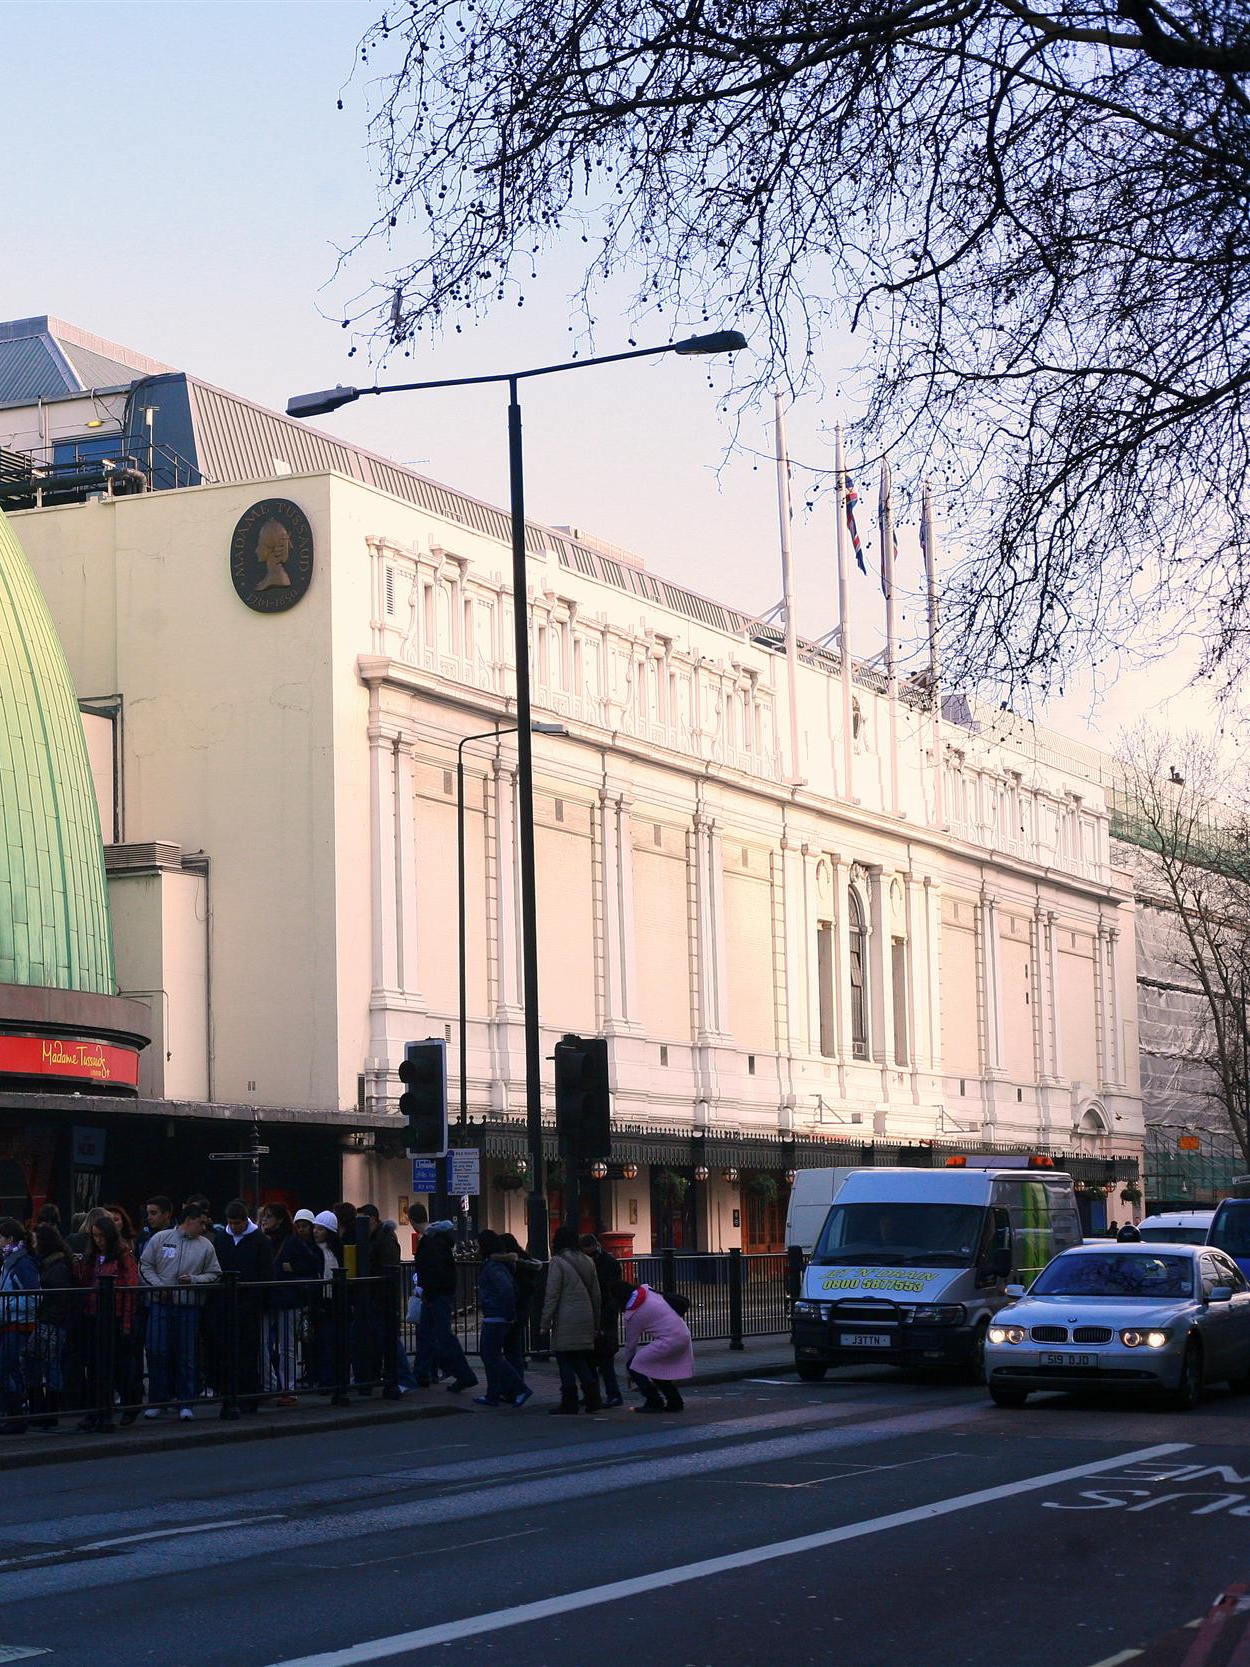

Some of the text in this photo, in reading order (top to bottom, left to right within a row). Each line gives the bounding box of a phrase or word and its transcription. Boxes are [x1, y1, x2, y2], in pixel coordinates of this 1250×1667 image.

[235, 502, 310, 577] MADAME TUSSAUD
[42, 1040, 78, 1066] Madame
[822, 1278, 860, 1290] 0800
[875, 1269, 940, 1280] DRAIN
